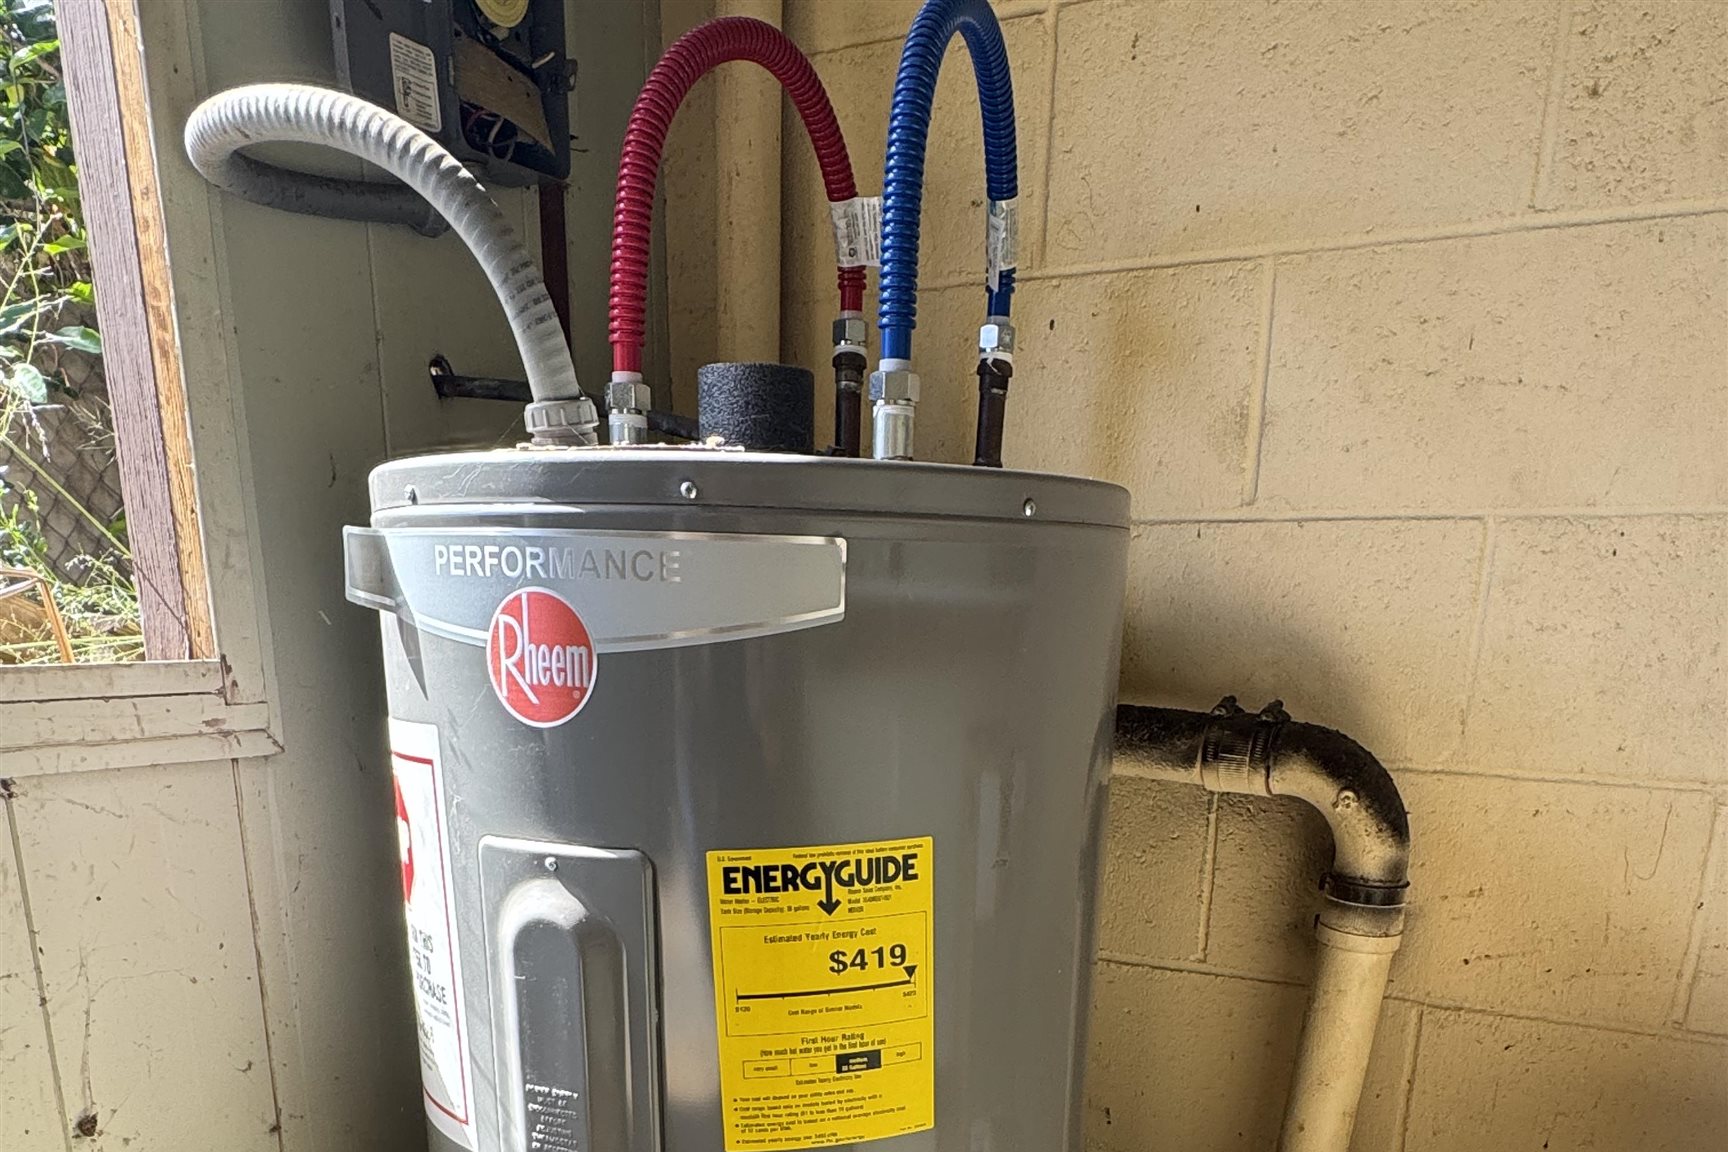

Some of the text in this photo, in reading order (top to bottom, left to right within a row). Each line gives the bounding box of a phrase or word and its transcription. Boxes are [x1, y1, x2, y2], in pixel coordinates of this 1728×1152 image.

[435, 544, 682, 584] PERFORMANCE
[501, 593, 590, 704] Rheem
[722, 853, 919, 897] ENERGYGUIDE
[764, 934, 803, 944] Estimated
[805, 932, 830, 942] Yearly
[832, 930, 858, 940] Energy
[829, 944, 907, 975] $419
